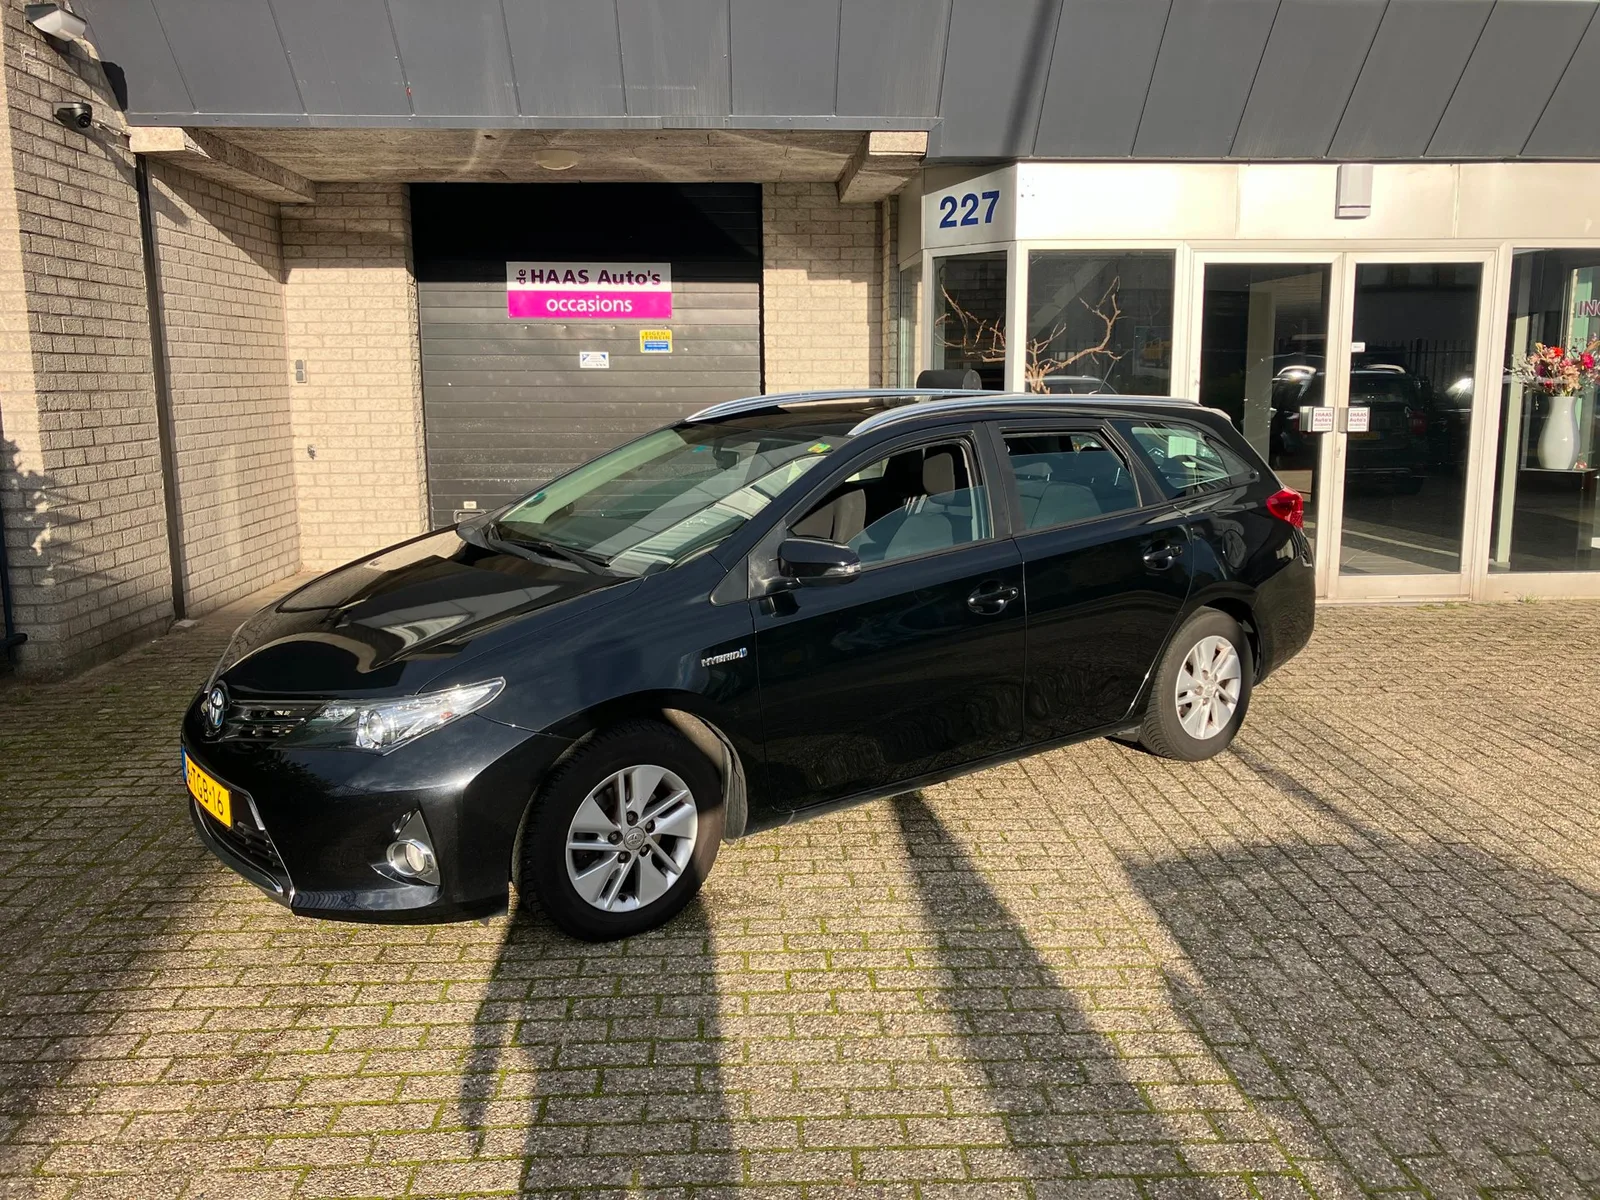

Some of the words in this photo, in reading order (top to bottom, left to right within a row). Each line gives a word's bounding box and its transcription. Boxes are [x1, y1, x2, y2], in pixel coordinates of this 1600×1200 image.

[939, 190, 1000, 229] 227
[516, 268, 527, 285] de
[530, 269, 590, 284] HAAS
[597, 269, 661, 286] Auto's
[546, 295, 633, 313] occasions
[701, 650, 740, 667] HYBRID
